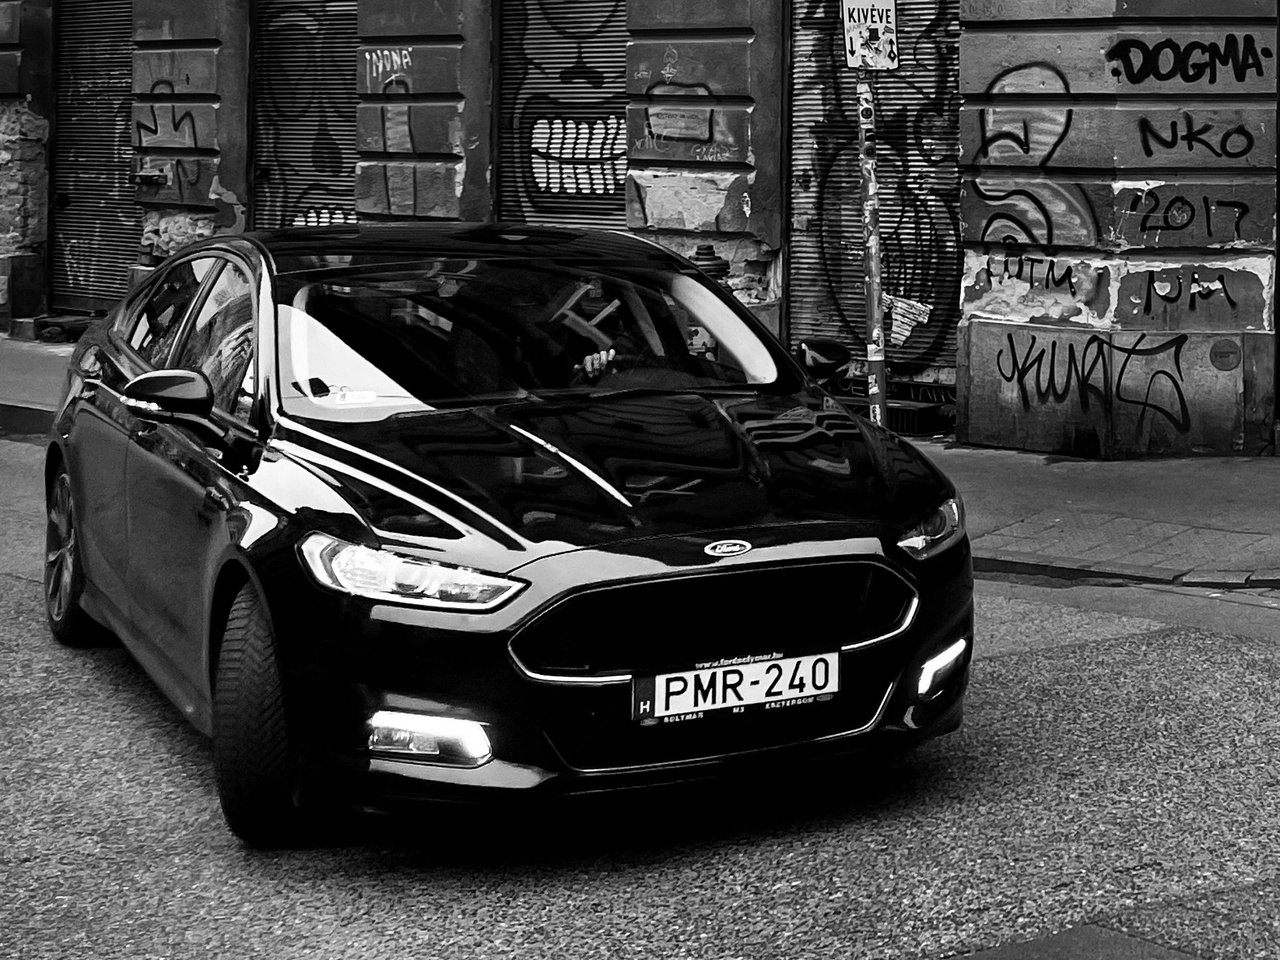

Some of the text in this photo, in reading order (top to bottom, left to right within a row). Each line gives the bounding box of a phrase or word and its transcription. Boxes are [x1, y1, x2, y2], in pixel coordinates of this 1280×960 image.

[847, 3, 893, 24] KIVÉVE
[1106, 33, 1265, 85] DOGMA
[1129, 190, 1249, 238] 2017
[639, 700, 651, 715] H
[664, 657, 830, 712] PMR-240
